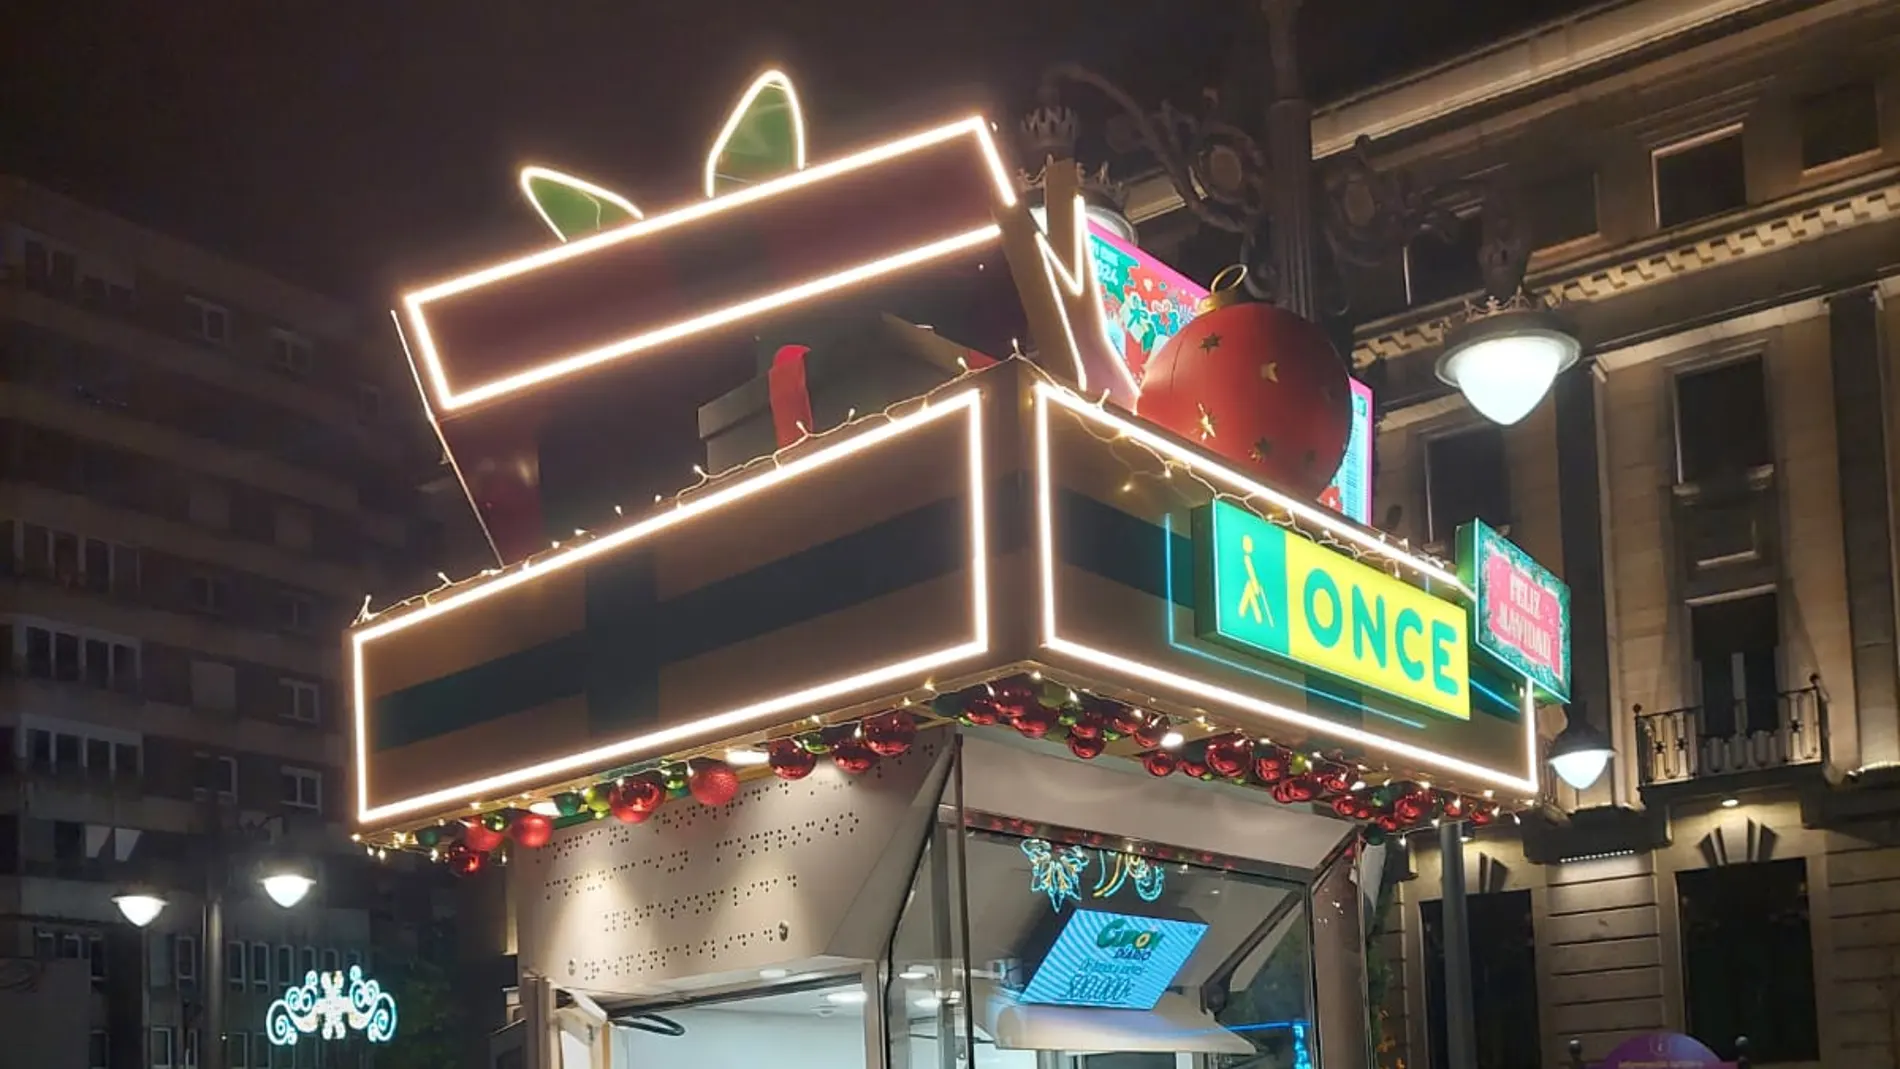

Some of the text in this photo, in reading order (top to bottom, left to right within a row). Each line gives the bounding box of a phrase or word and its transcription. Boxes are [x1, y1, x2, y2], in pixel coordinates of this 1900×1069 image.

[1509, 570, 1542, 621] FELIZ
[1303, 568, 1459, 696] ONCE
[1500, 601, 1551, 660] NAVIDAD
